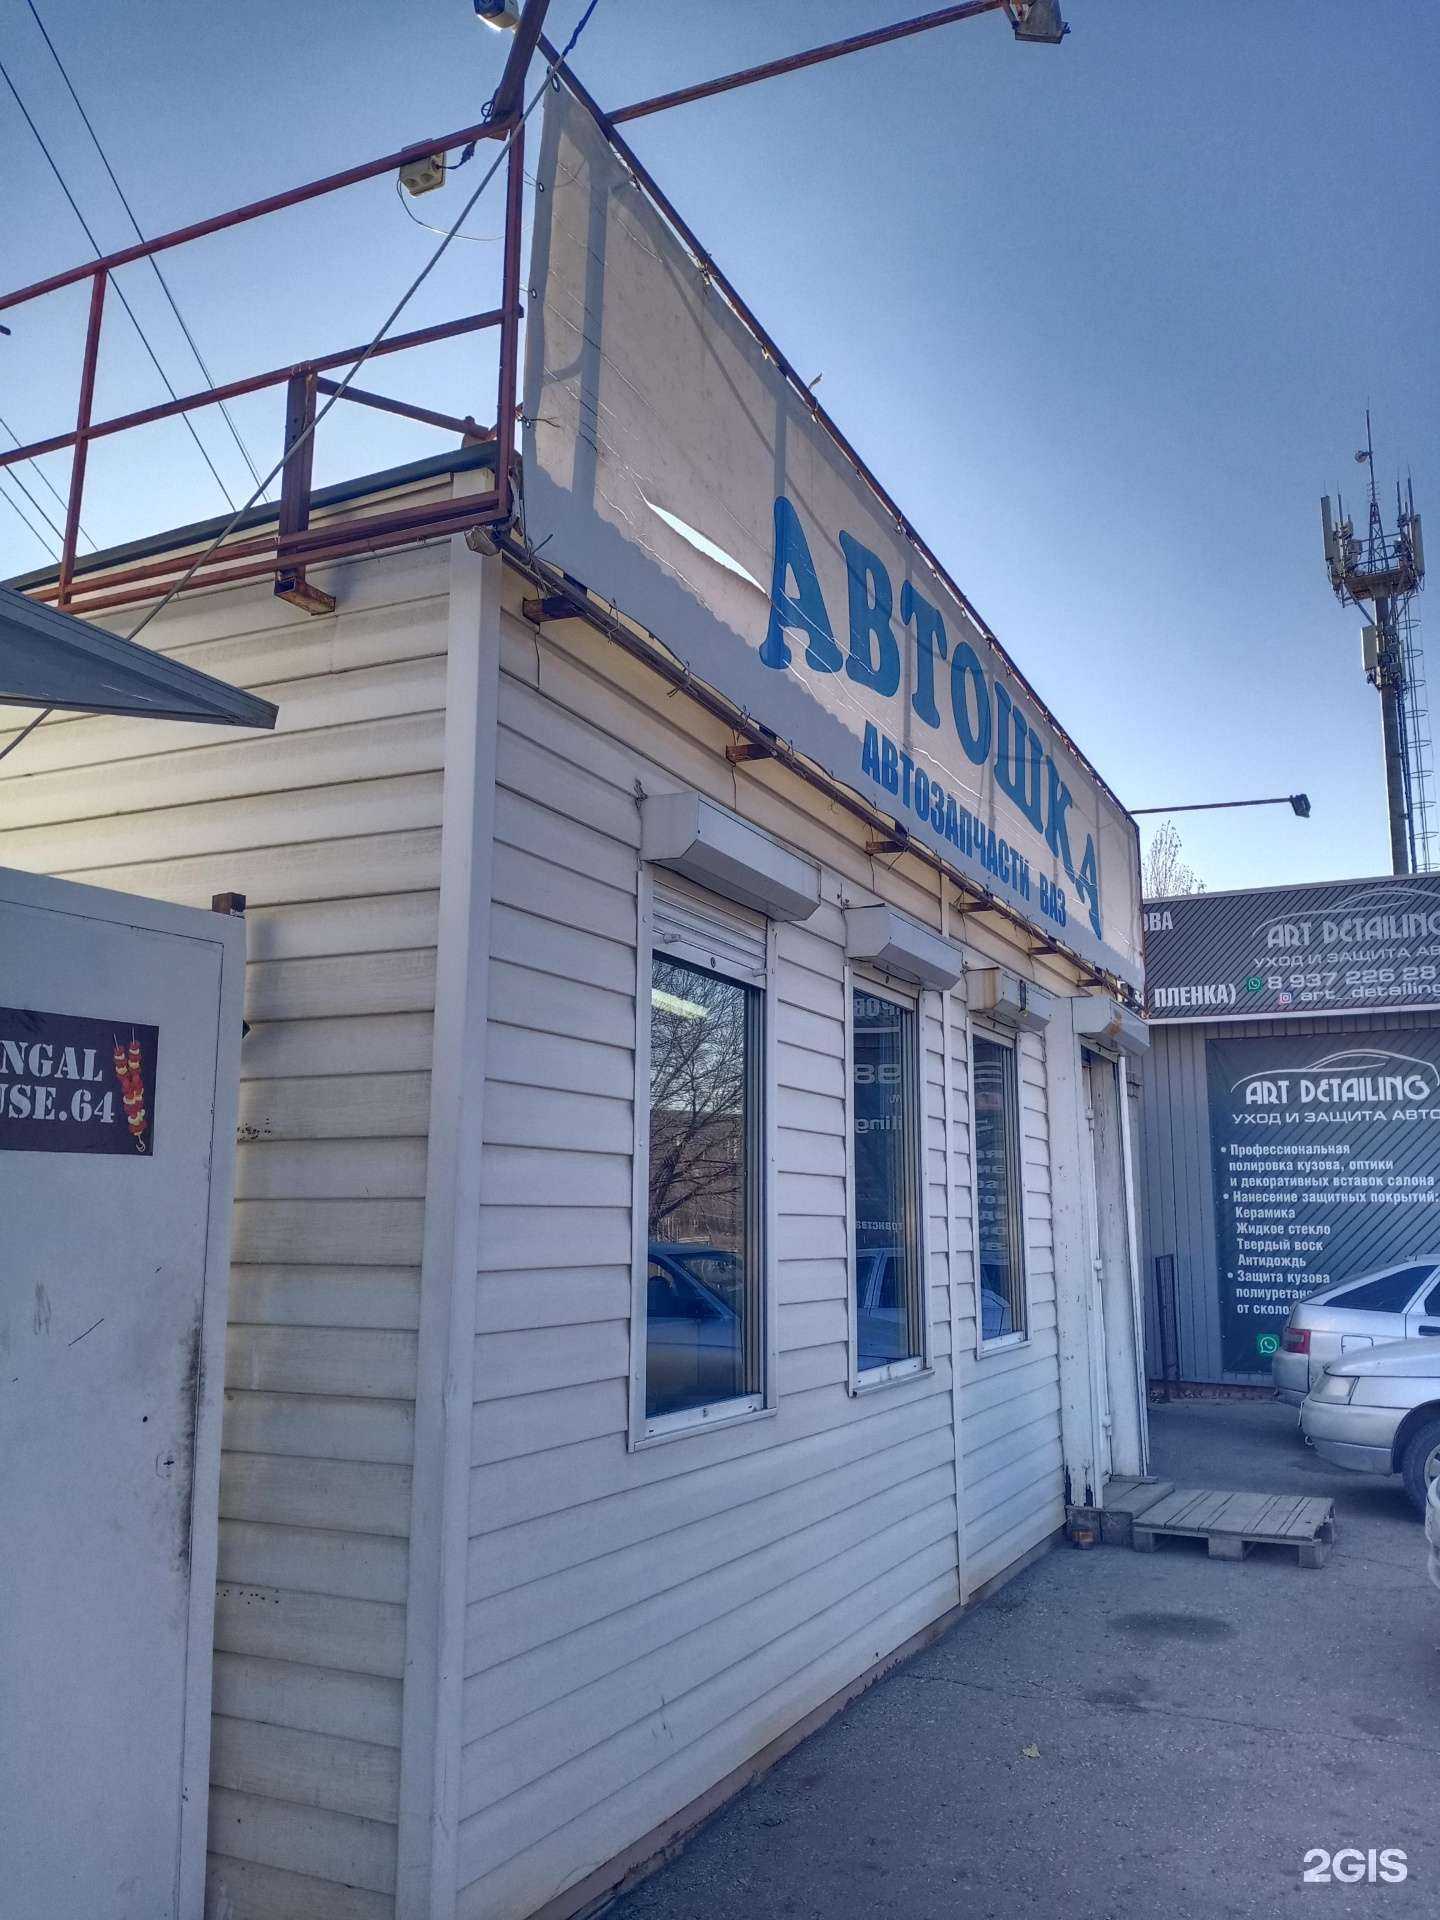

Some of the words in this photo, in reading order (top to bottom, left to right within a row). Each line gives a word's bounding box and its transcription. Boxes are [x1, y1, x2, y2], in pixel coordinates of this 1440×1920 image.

[759, 495, 1102, 941] АВТОШКА
[861, 719, 1030, 902] АВТОЗАПЧАСТИ
[1039, 871, 1067, 928] ВАЗ
[1267, 921, 1312, 949] ART
[1254, 955, 1304, 968] УХОД
[1308, 954, 1322, 965] И
[1327, 947, 1411, 963] ЗАЩИТА
[1267, 976, 1282, 990] 8
[1289, 971, 1338, 988] 937
[1345, 968, 1395, 985] 226
[1403, 965, 1436, 981] 28
[1154, 983, 1237, 1008] ПЛЕНКА)
[1245, 1080, 1290, 1105] ART
[1300, 1074, 1431, 1103] DETAILING
[1232, 1113, 1281, 1125] УХОД
[1286, 1112, 1299, 1123] И
[1304, 1111, 1387, 1123] ЗАЩИТА
[1392, 1109, 1440, 1121] АВТО
[1230, 1144, 1350, 1157] Профессиональная
[1229, 1161, 1294, 1173] полировка
[1297, 1161, 1345, 1173] кузова,
[1350, 1160, 1394, 1170] оптики
[1230, 1177, 1237, 1186] и
[1241, 1176, 1329, 1189] декоративных
[1333, 1175, 1383, 1187] вставок
[1387, 1175, 1435, 1186] салона
[1233, 1190, 1298, 1203] Нанесение
[1302, 1192, 1367, 1204] защитных
[1371, 1190, 1440, 1205] покрытий:
[1235, 1206, 1296, 1220] Керамика
[1236, 1222, 1285, 1235] Жидкое
[1288, 1224, 1331, 1235] стекло
[1237, 1238, 1290, 1252] Твердый
[1294, 1241, 1324, 1251] воск
[1238, 1254, 1306, 1268] Антидождь
[1237, 1270, 1283, 1284] Защита
[1287, 1273, 1330, 1285] кузова
[1237, 1304, 1250, 1314] от
[1253, 1304, 1291, 1315] сколо
